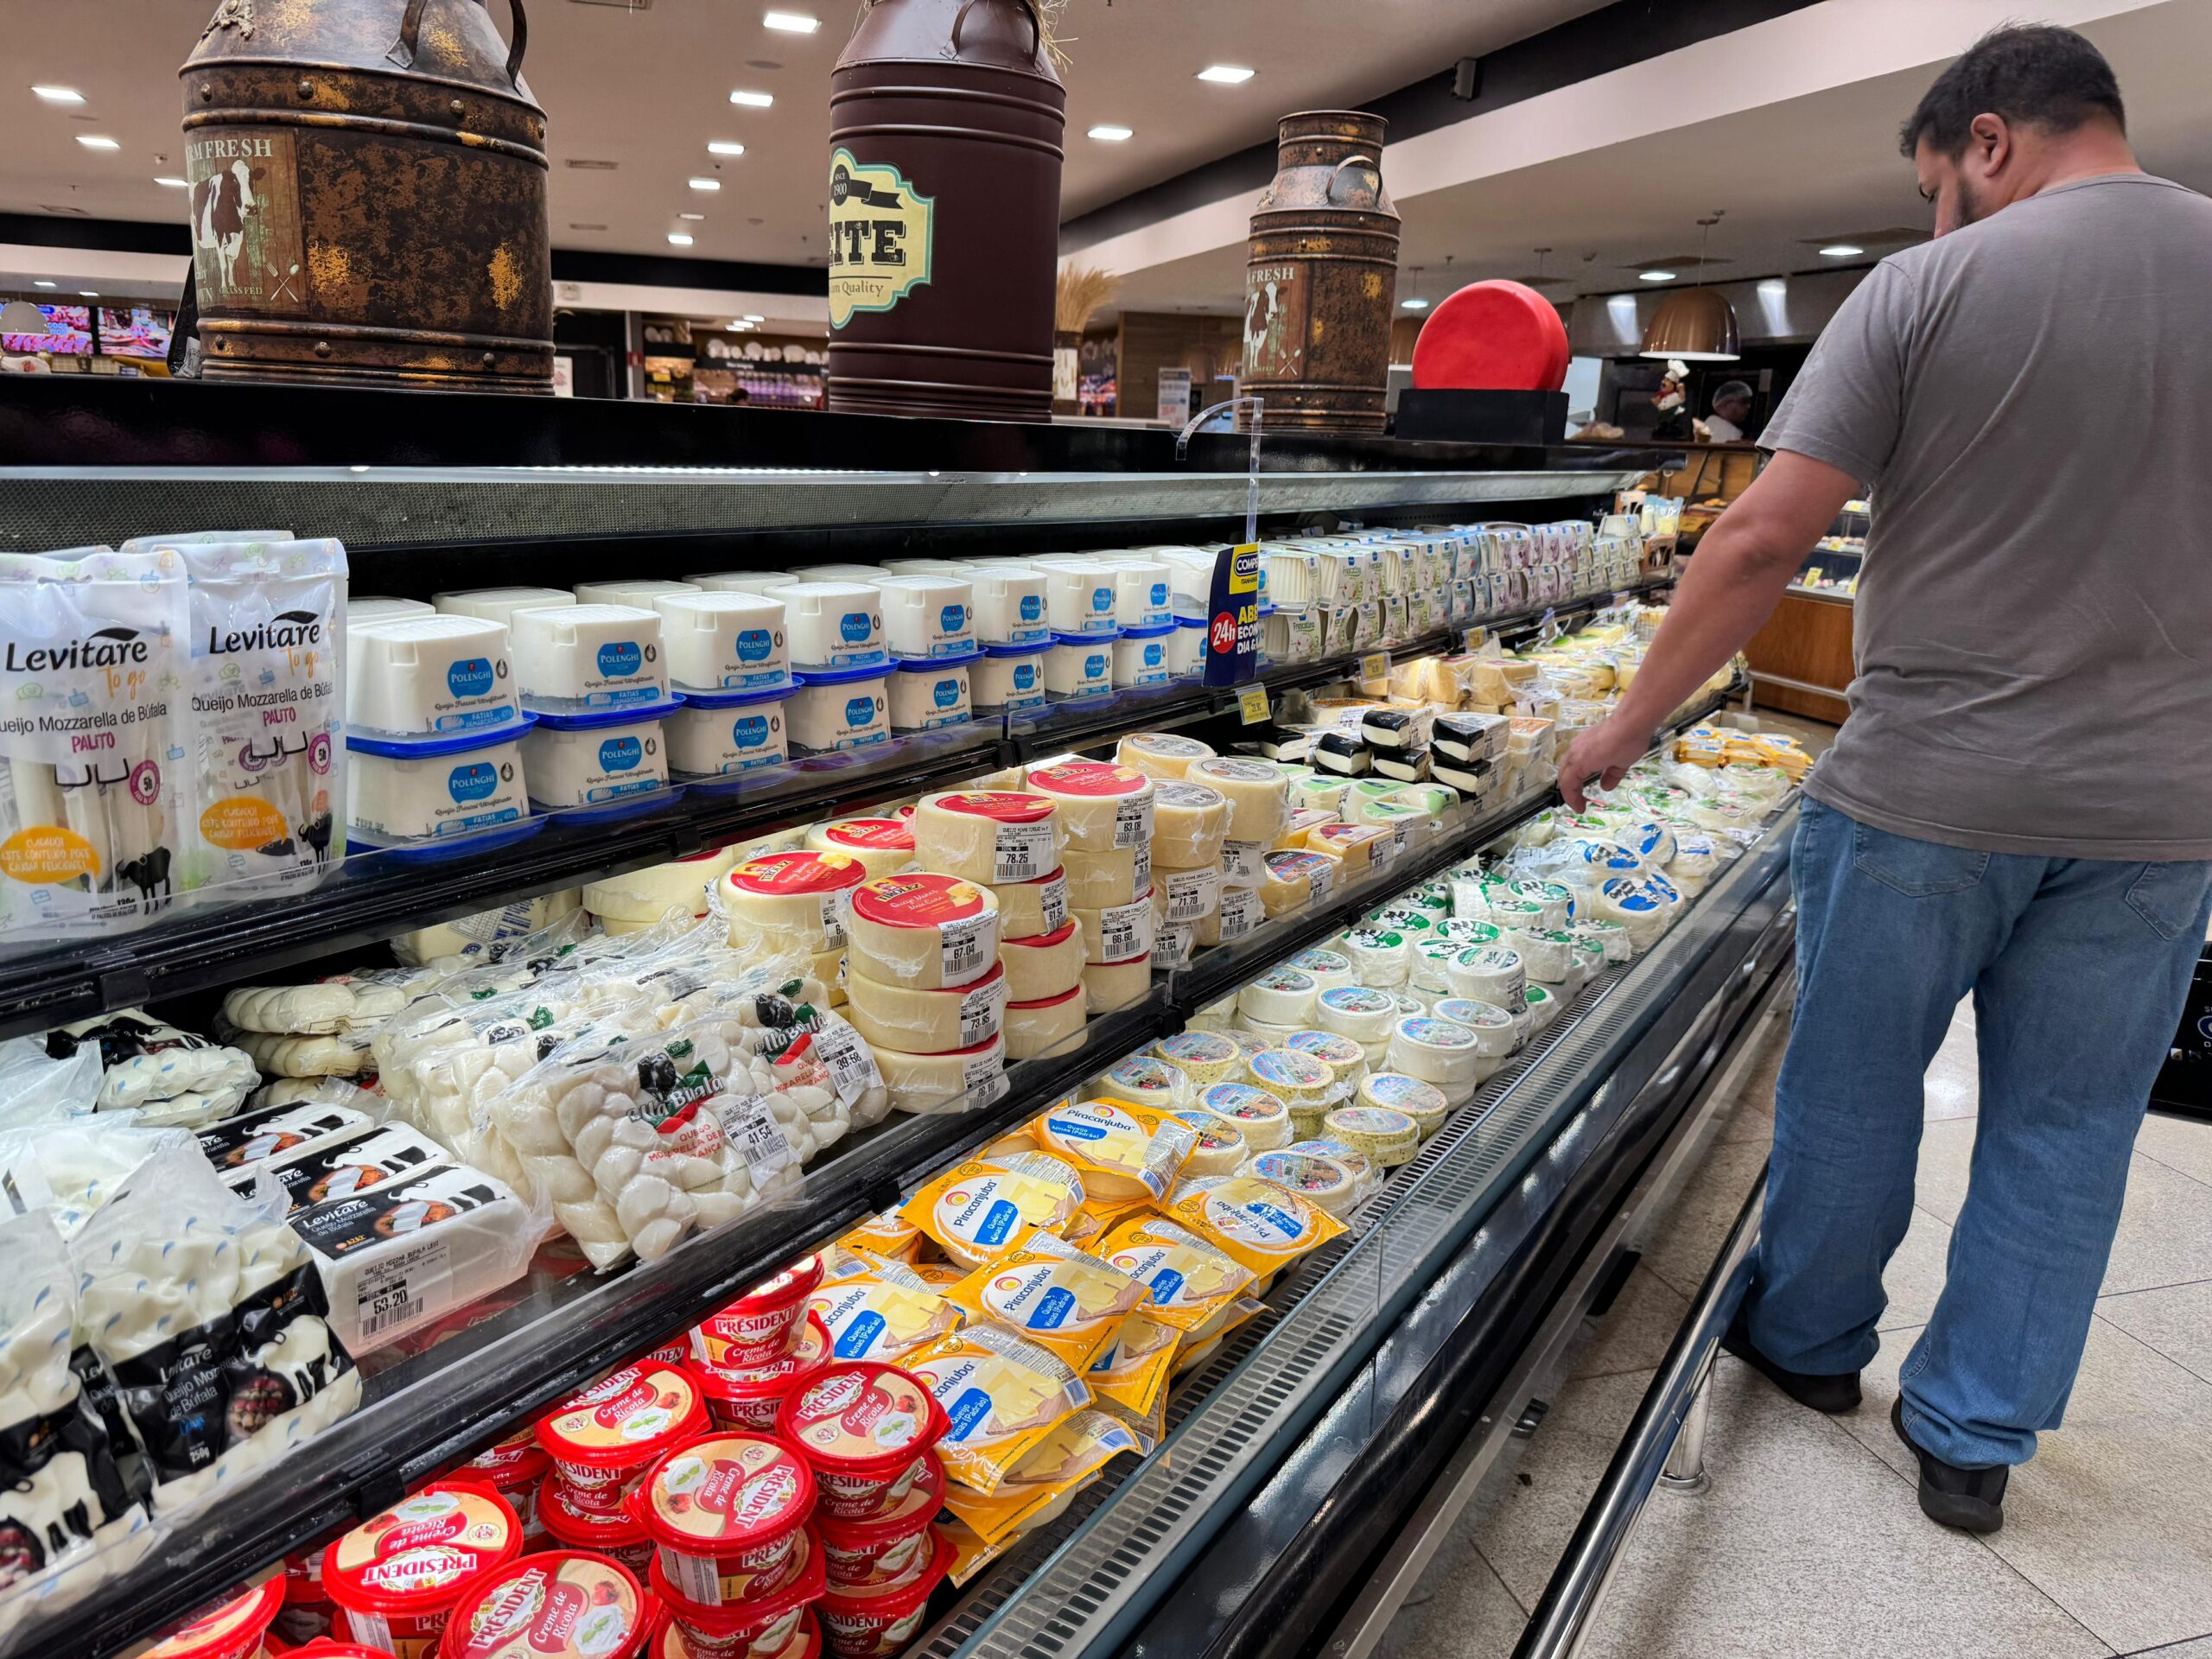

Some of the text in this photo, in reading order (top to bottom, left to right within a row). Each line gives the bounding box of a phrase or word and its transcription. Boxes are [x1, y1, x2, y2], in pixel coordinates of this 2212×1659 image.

[206, 138, 273, 159] FRESH
[835, 172, 846, 181] SINCE
[833, 182, 848, 196] 1900
[830, 219, 906, 266] ITE
[1251, 267, 1295, 283] FRESH
[244, 285, 263, 295] FED
[842, 279, 884, 297] Quality
[842, 622, 871, 631] POLENGHI
[941, 613, 964, 623] POLENGHI
[209, 622, 321, 655] Levitare
[1212, 619, 1236, 647] 24h
[1314, 636, 1319, 647] 3
[738, 639, 771, 650] POLENGHI
[1237, 642, 1251, 655] DIA
[6, 639, 149, 672] Levitare
[305, 650, 320, 679] go
[600, 652, 639, 664] POLENGHI
[127, 669, 146, 701] go
[450, 671, 492, 683] POLENGHI
[192, 685, 314, 715] Queijo Mozzarella de
[435, 702, 454, 711] Queijo
[0, 701, 168, 736] ueijo Mozzarella de Búfala
[263, 706, 296, 728] PALITO
[472, 710, 494, 720] FATIAS
[847, 706, 874, 716] POLENGHI
[735, 726, 767, 735] POLENGHI
[71, 734, 116, 754] PALITO
[318, 748, 327, 762] 5h
[601, 747, 640, 761] POLENGHI
[143, 776, 154, 791] 5h
[452, 774, 495, 789] POLENGHI
[435, 806, 455, 817] Queijo
[474, 812, 497, 823] FATIAS
[877, 882, 923, 901] TIROLEZ
[836, 1052, 862, 1071] 39,58
[1066, 1109, 1132, 1131] Piracanjuba
[1066, 1124, 1088, 1133] Queijo
[748, 1125, 772, 1146] 41,54
[1052, 1125, 1099, 1140] Minas (Padrão)
[954, 1179, 998, 1227] Piracanjuba
[303, 1199, 368, 1229] Levitare
[988, 1213, 1002, 1230] Queijo
[1001, 1205, 1015, 1226] (Padrão)
[365, 1262, 385, 1275] QUEIJO
[1130, 1249, 1166, 1280] acanjuba
[1004, 1268, 1052, 1311] Piracanjuba
[373, 1289, 408, 1315] 53,20
[823, 1289, 867, 1326] acanjuba
[1041, 1299, 1058, 1315] Queijo
[1044, 1293, 1072, 1327] Minas (Padrão)
[716, 1306, 795, 1334] PRÉSIDENT
[847, 1317, 882, 1357] Minas (Padrão)
[848, 1324, 866, 1342] Queijo
[733, 1338, 781, 1357] Creme de
[743, 1349, 772, 1363] Ricota
[932, 1363, 976, 1398] canjuba
[181, 1386, 218, 1413] Búfala
[600, 1386, 645, 1420] Creme de
[799, 1372, 867, 1420] PRÉSIDENT
[613, 1397, 646, 1421] Ricota
[845, 1391, 878, 1427] Creme de
[861, 1402, 884, 1430] Ricota
[950, 1403, 971, 1424] Queijo
[964, 1395, 989, 1423] (Padrão)
[189, 1446, 210, 1465] 250g
[565, 1483, 608, 1500] Creme de
[703, 1471, 726, 1497] Ricota
[715, 1467, 741, 1507] Creme de
[574, 1495, 601, 1507] Ricota
[735, 1465, 795, 1529] PRÉSIDENT
[824, 1497, 874, 1509] Creme de
[833, 1505, 865, 1516] Ricota
[401, 1518, 447, 1536] Ricota
[389, 1526, 457, 1549] Creme de
[363, 1554, 476, 1584] PRÉSIDENT
[848, 1564, 861, 1573] de
[470, 1567, 547, 1648] PRÉSIDENT
[534, 1591, 568, 1643] Creme de
[552, 1603, 579, 1639] Ricota
[853, 1637, 868, 1646] de
